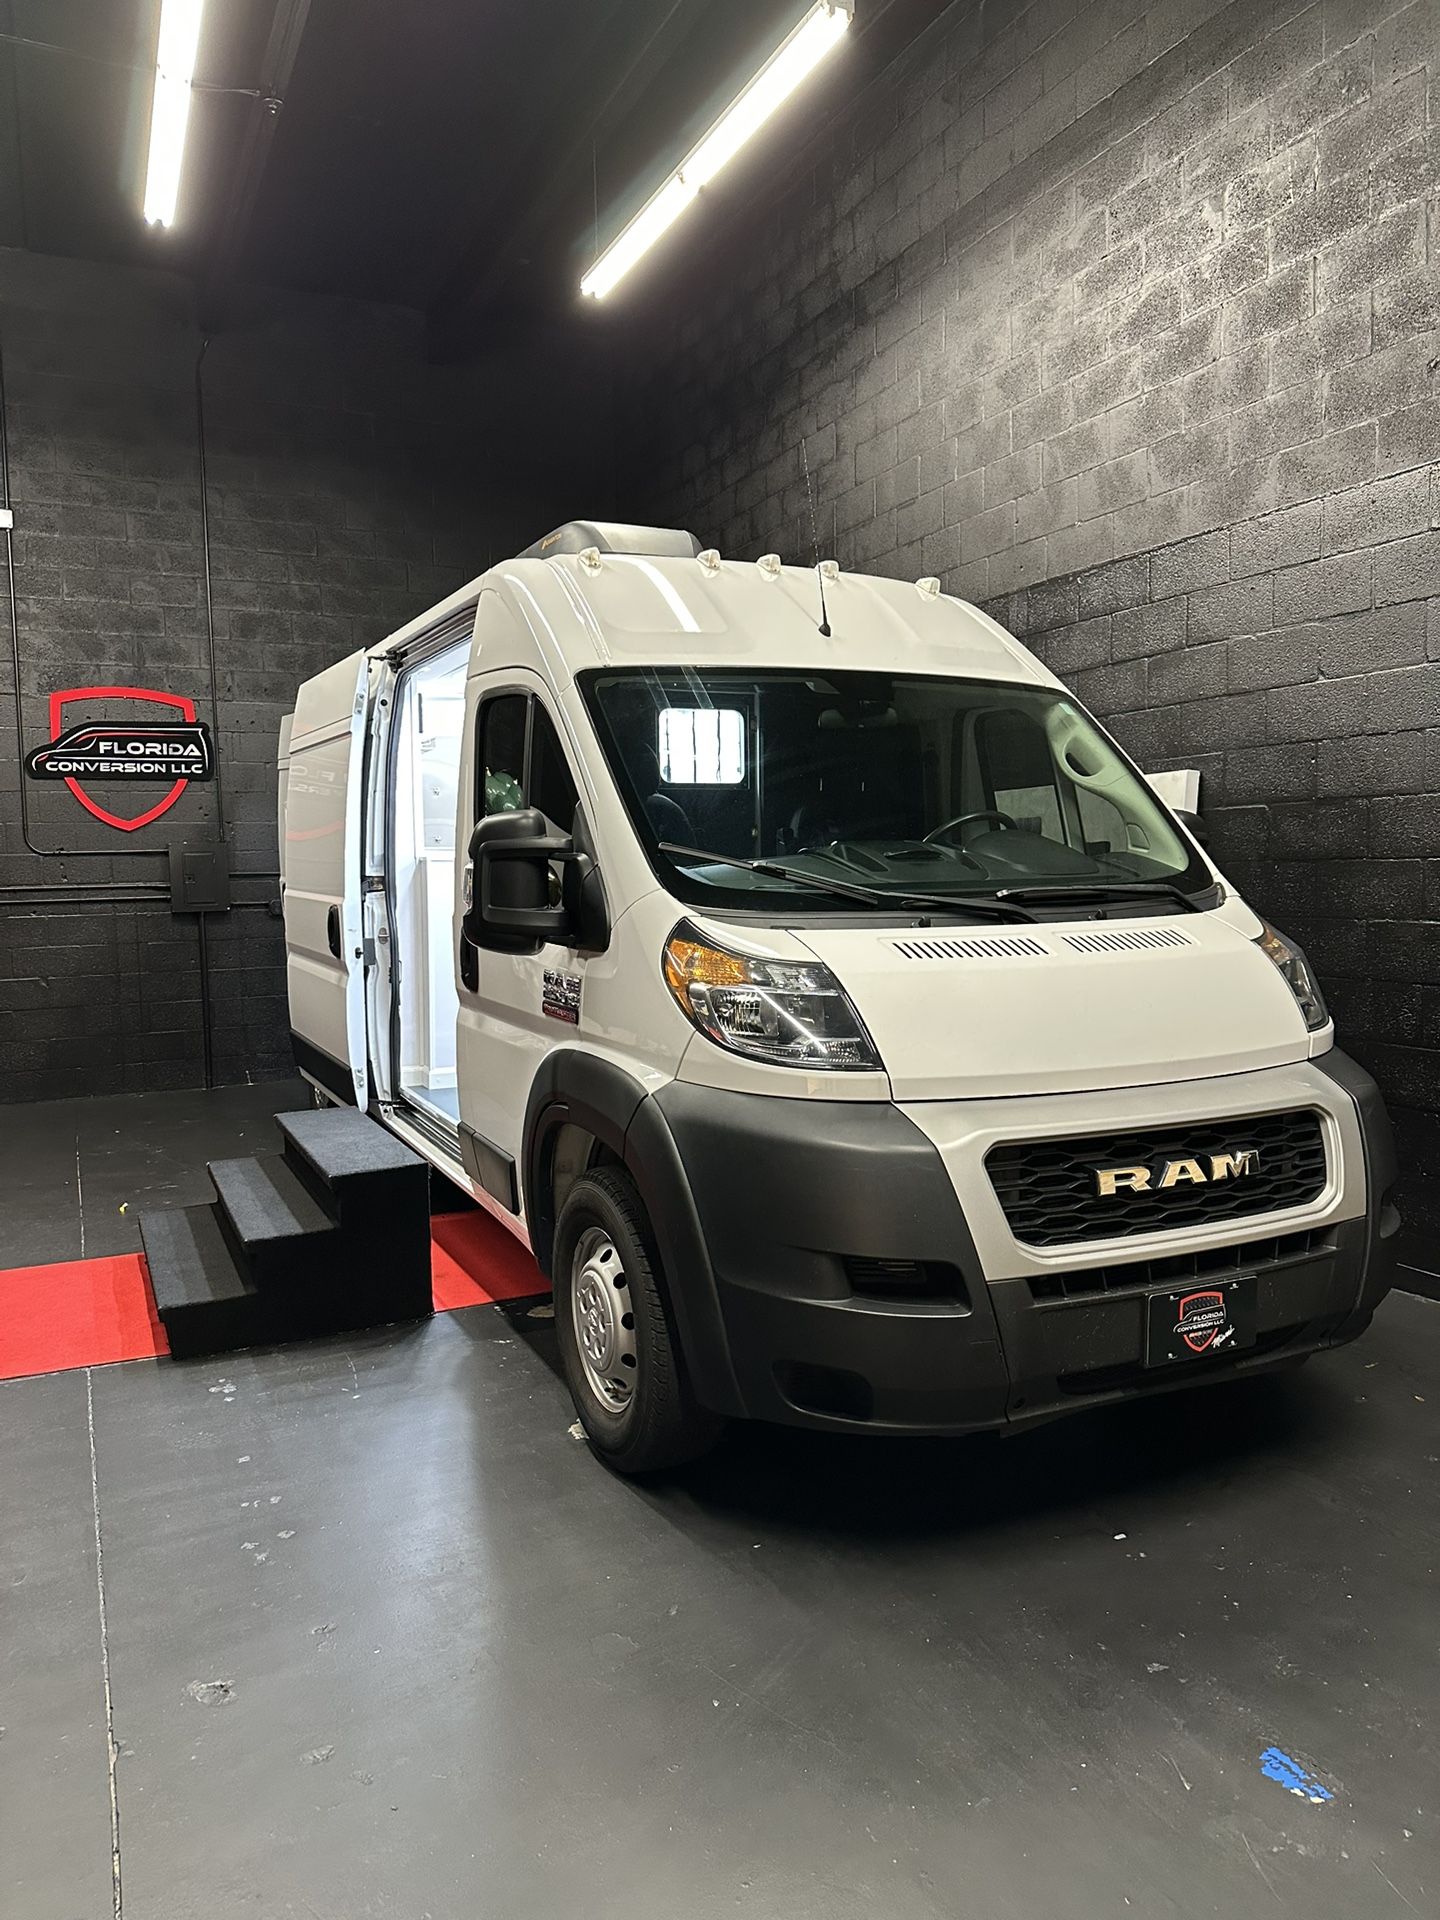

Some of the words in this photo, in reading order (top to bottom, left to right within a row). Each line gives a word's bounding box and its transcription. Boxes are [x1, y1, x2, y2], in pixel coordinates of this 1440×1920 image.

[99, 741, 202, 757] FLORIDA
[45, 761, 166, 774] CONVERSION
[171, 763, 204, 774] LLC
[1095, 1149, 1261, 1197] RAM
[1193, 1311, 1224, 1322] FLORIDA
[1177, 1322, 1214, 1332] CONVERSION
